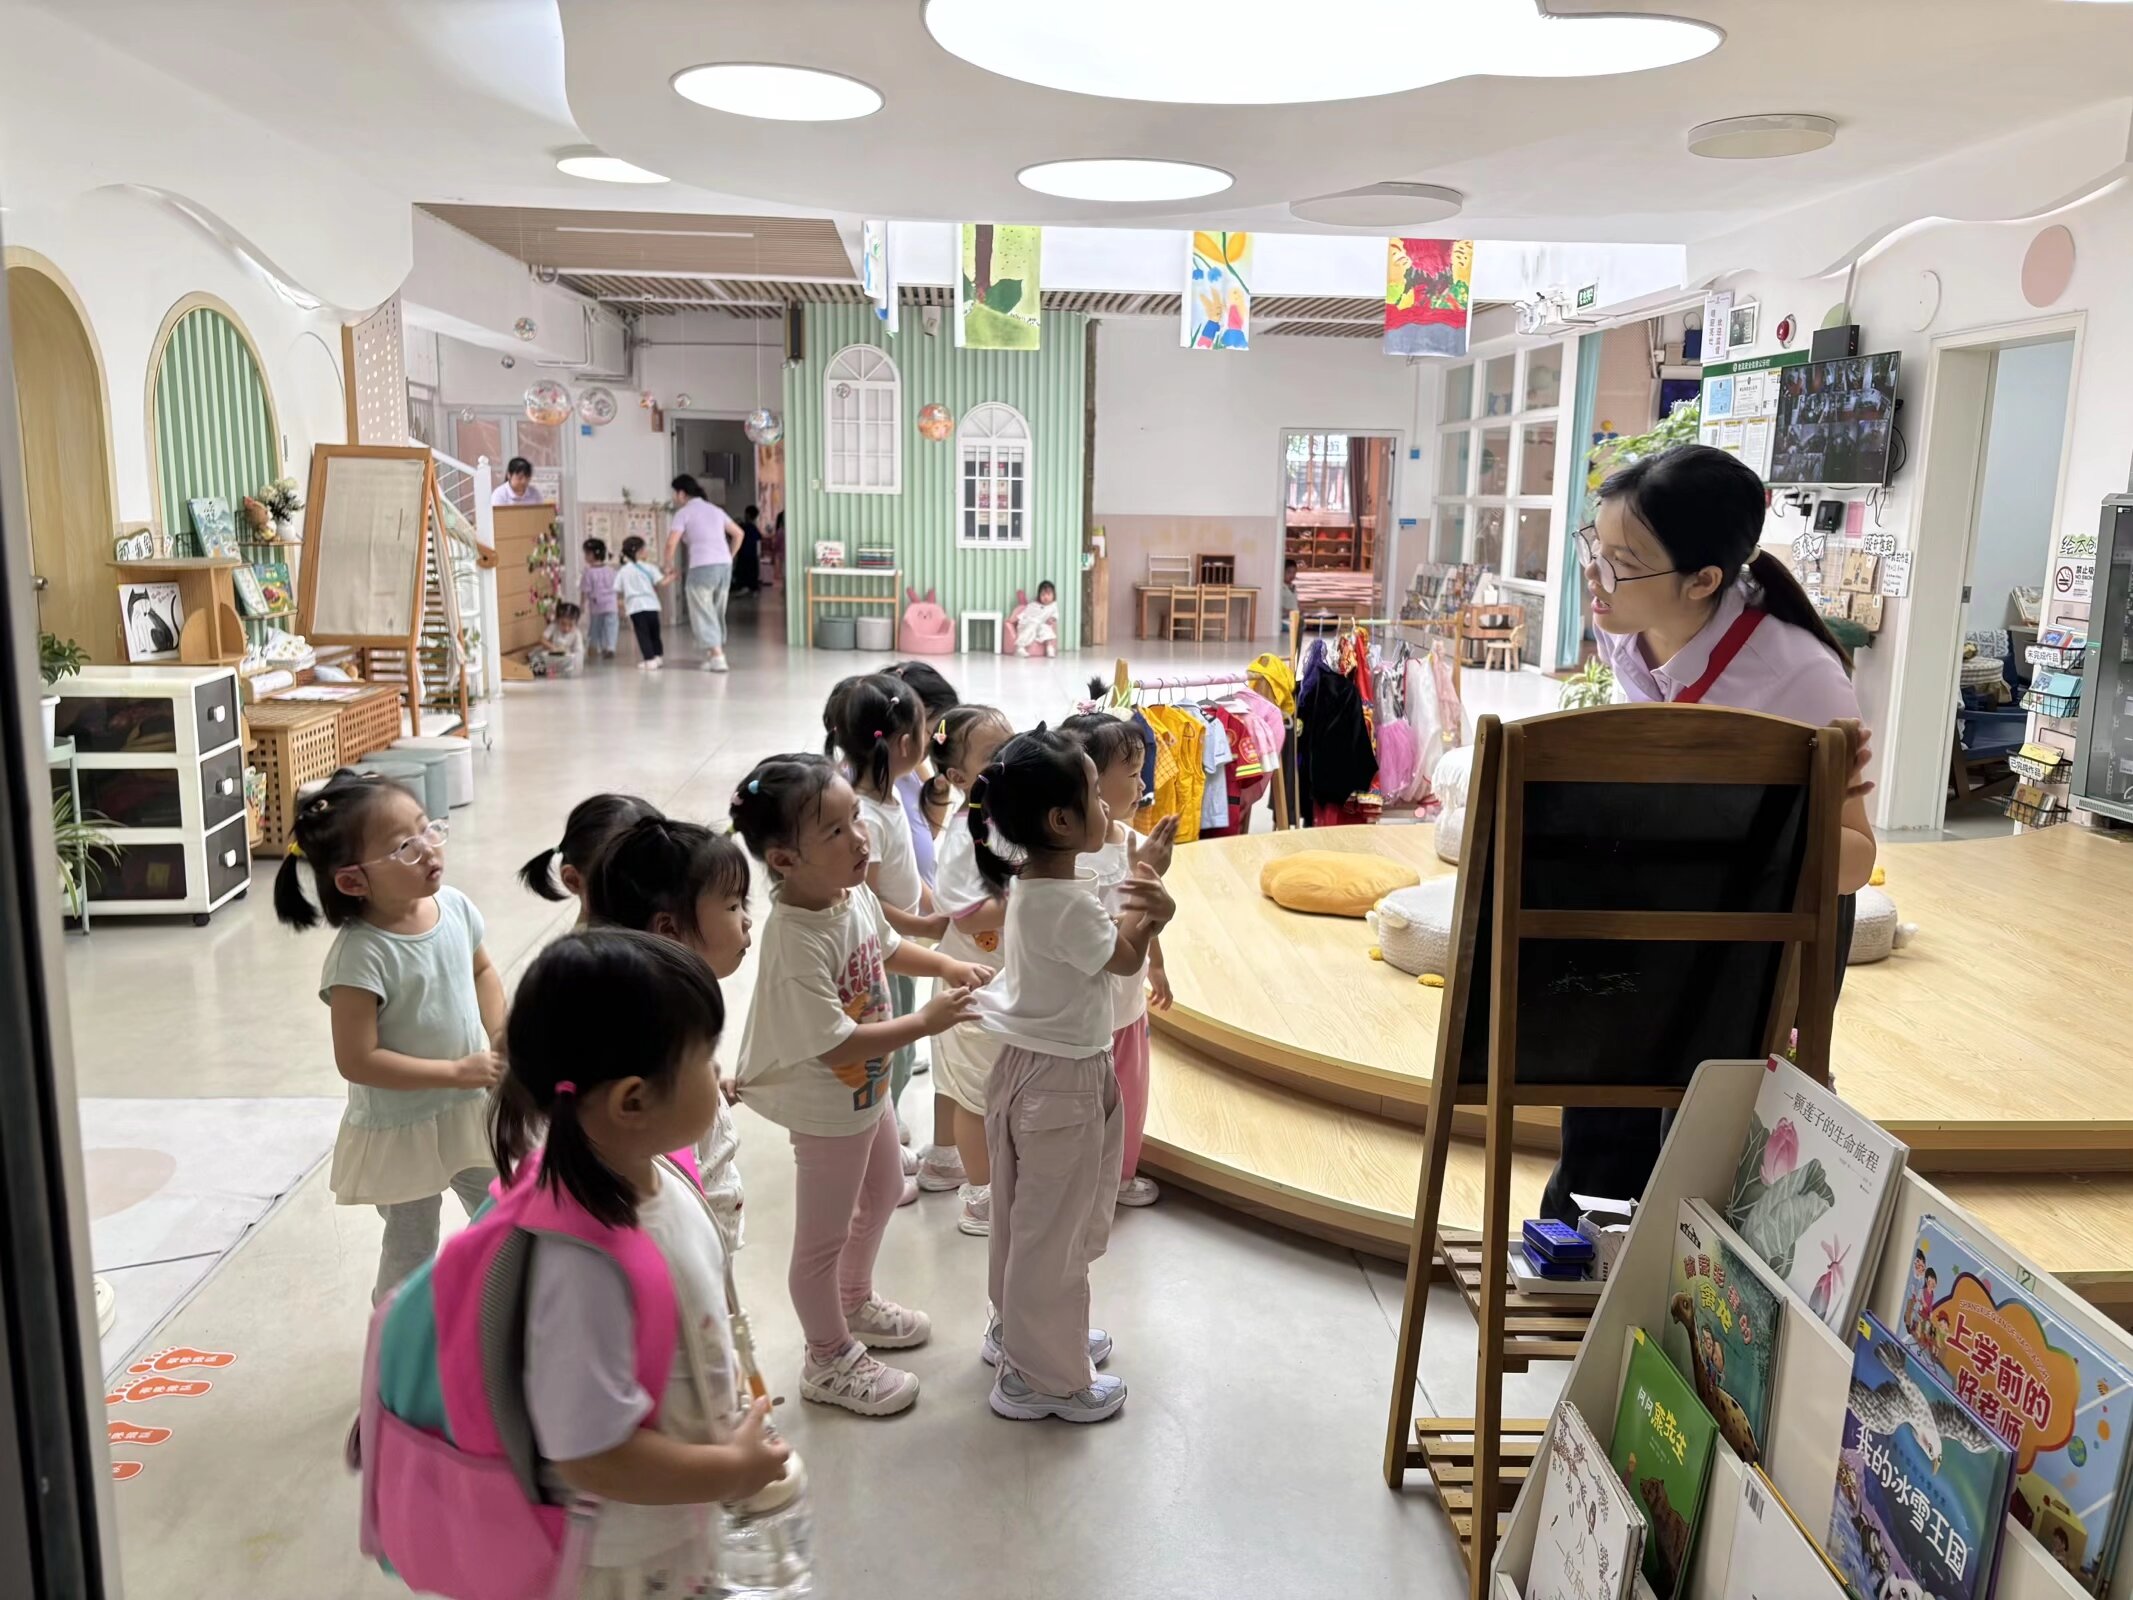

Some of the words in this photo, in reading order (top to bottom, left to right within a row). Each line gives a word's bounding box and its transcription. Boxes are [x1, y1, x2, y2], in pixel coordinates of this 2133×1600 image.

[2028, 650, 2059, 663] 未完成作品
[2010, 758, 2041, 778] 已完成作品
[1783, 1091, 1880, 1174] 一颗莲子的生命旅程
[2020, 1270, 2031, 1287] 2
[1946, 1313, 2053, 1431] 上学前的
[1956, 1367, 2025, 1448] 好老师
[1856, 1425, 1967, 1581] 我的冰雪王国
